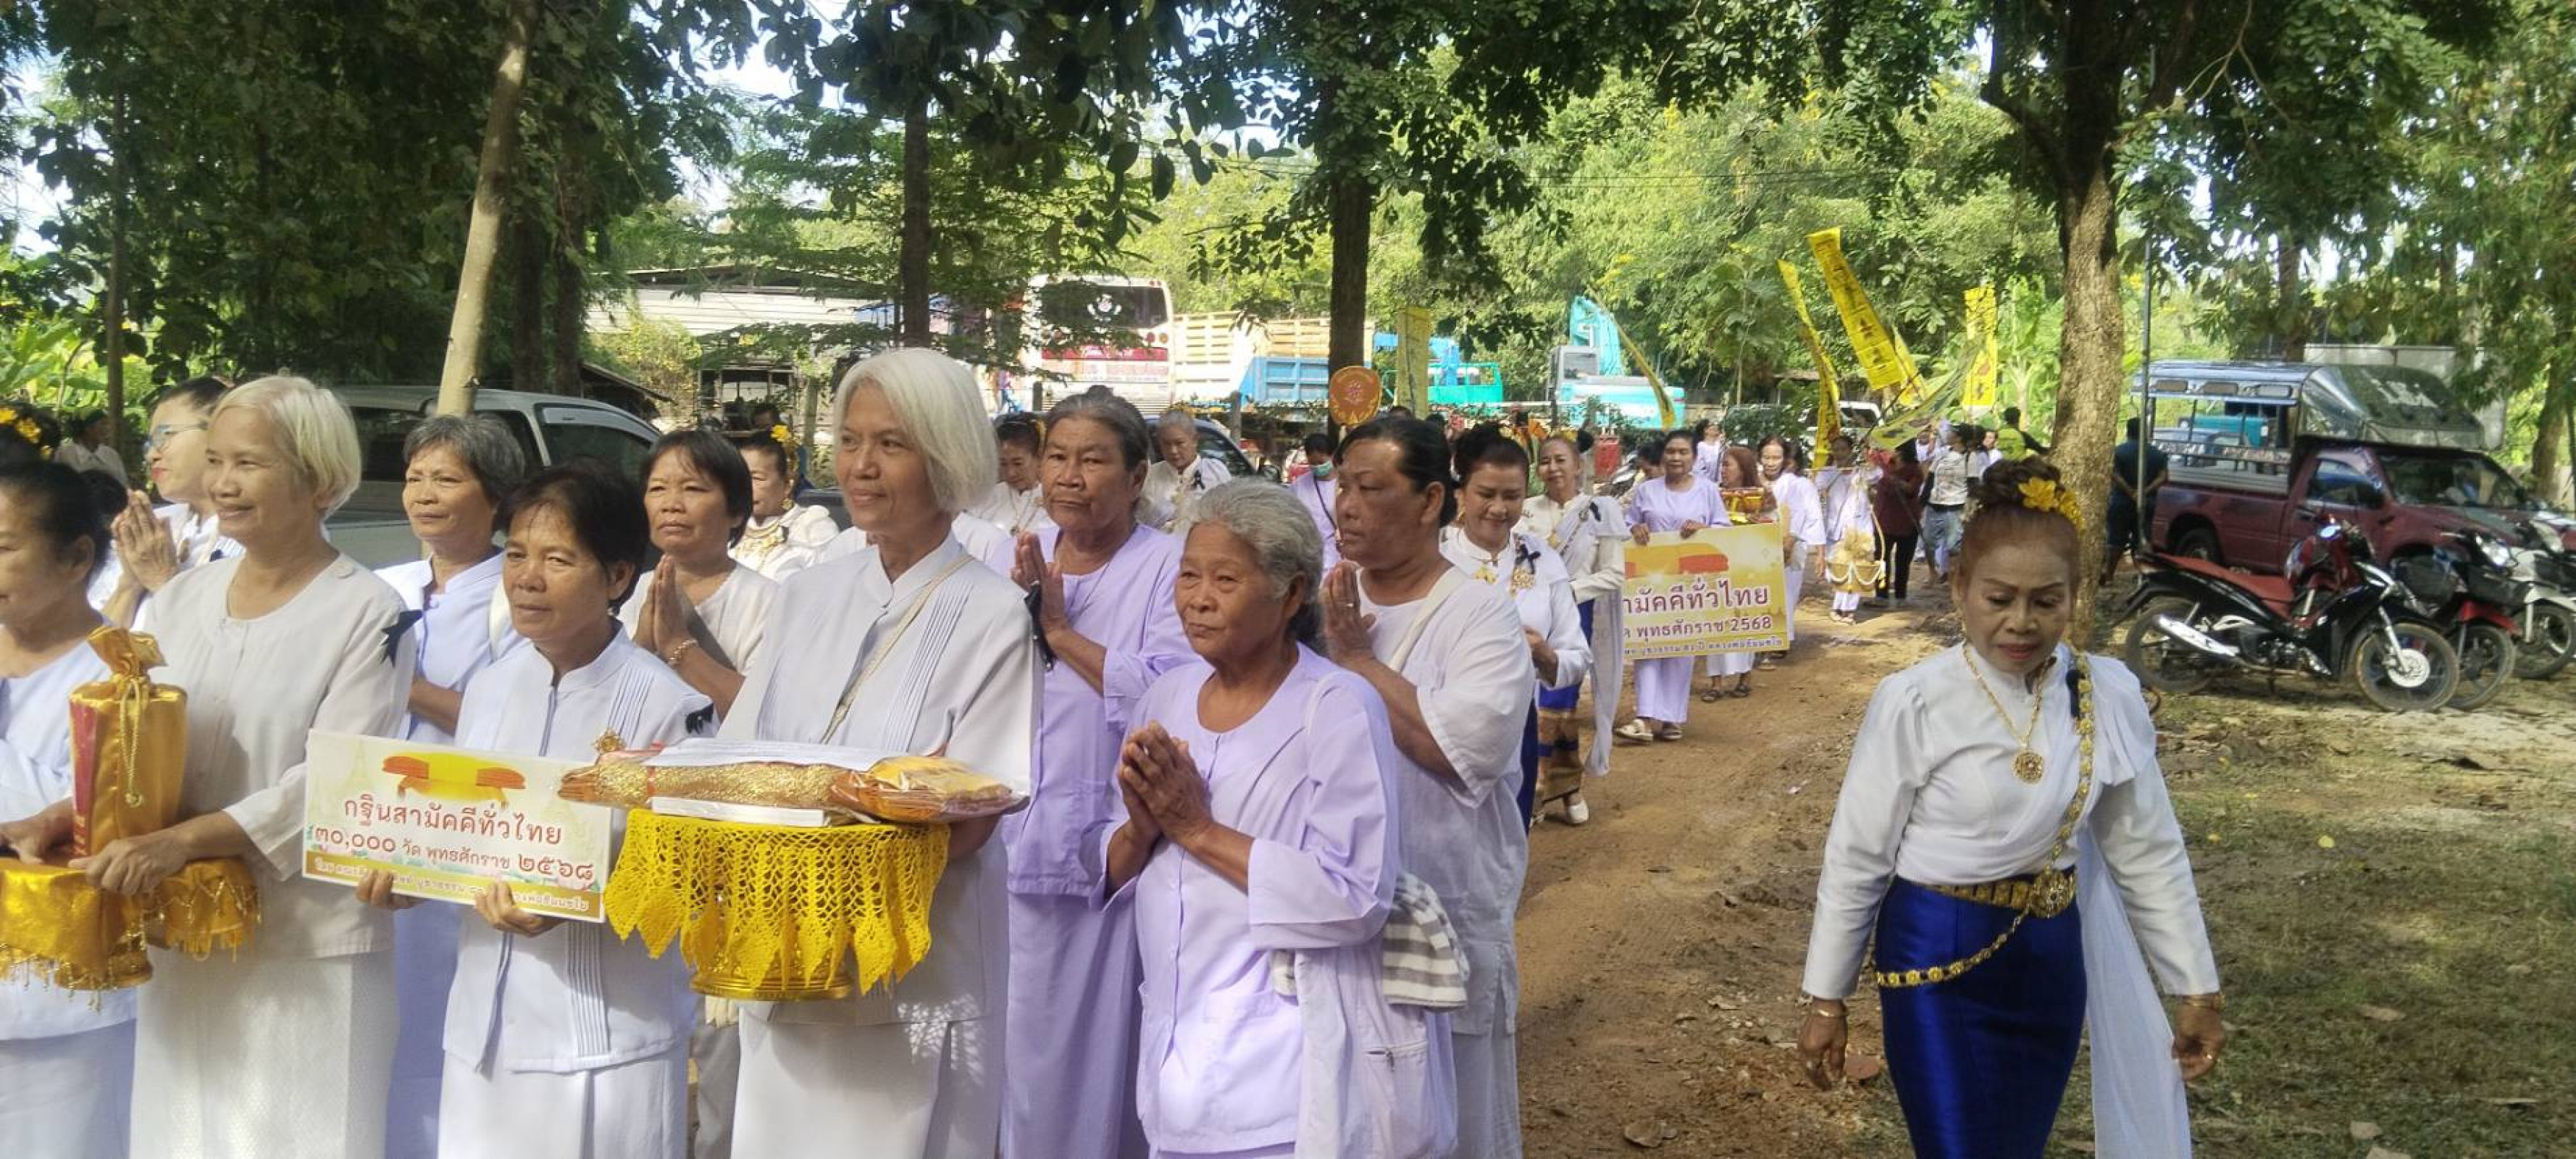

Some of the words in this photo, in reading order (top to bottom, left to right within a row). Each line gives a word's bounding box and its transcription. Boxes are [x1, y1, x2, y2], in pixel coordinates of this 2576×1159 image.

[1623, 577, 1768, 614] ามัคคีทั่วไทย
[1730, 616, 1772, 632] 2568
[344, 794, 562, 845] กฐินสามัคคีทั่วไทย
[314, 826, 396, 853] ๓๐,๐๐๐
[402, 841, 421, 856] วัด
[519, 853, 594, 880] ๒๕๖๘
